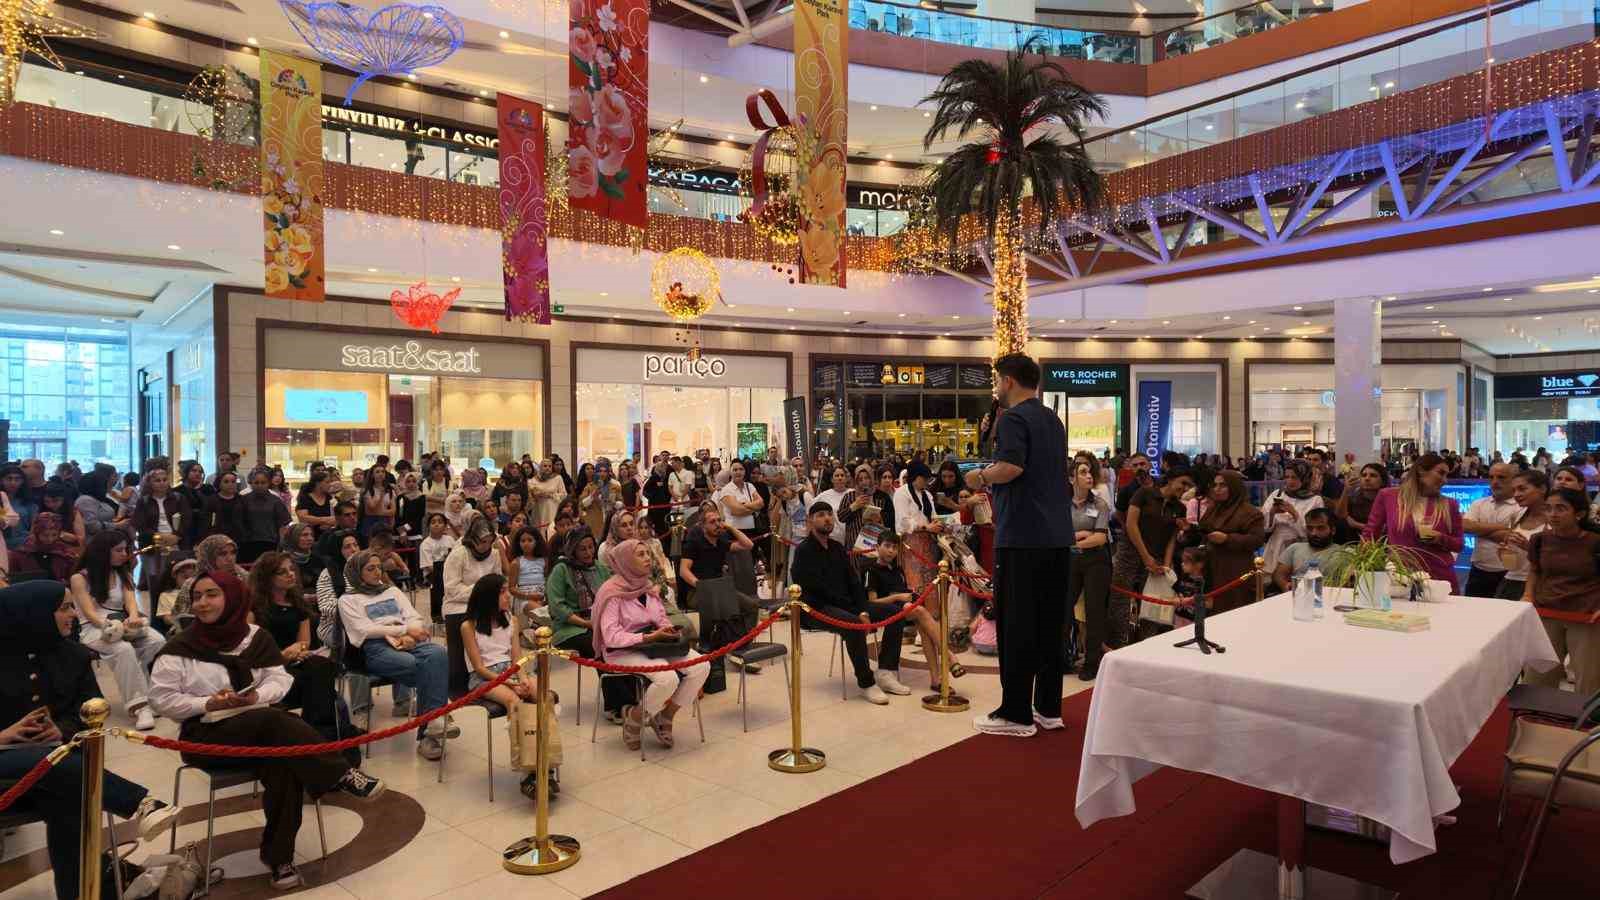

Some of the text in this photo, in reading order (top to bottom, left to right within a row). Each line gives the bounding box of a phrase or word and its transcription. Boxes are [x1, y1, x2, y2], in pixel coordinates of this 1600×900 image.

[341, 340, 481, 373] saat&saat
[1051, 370, 1117, 379] YVES ROCHER
[1541, 376, 1574, 388] blue
[1146, 395, 1160, 458] Otomotiv
